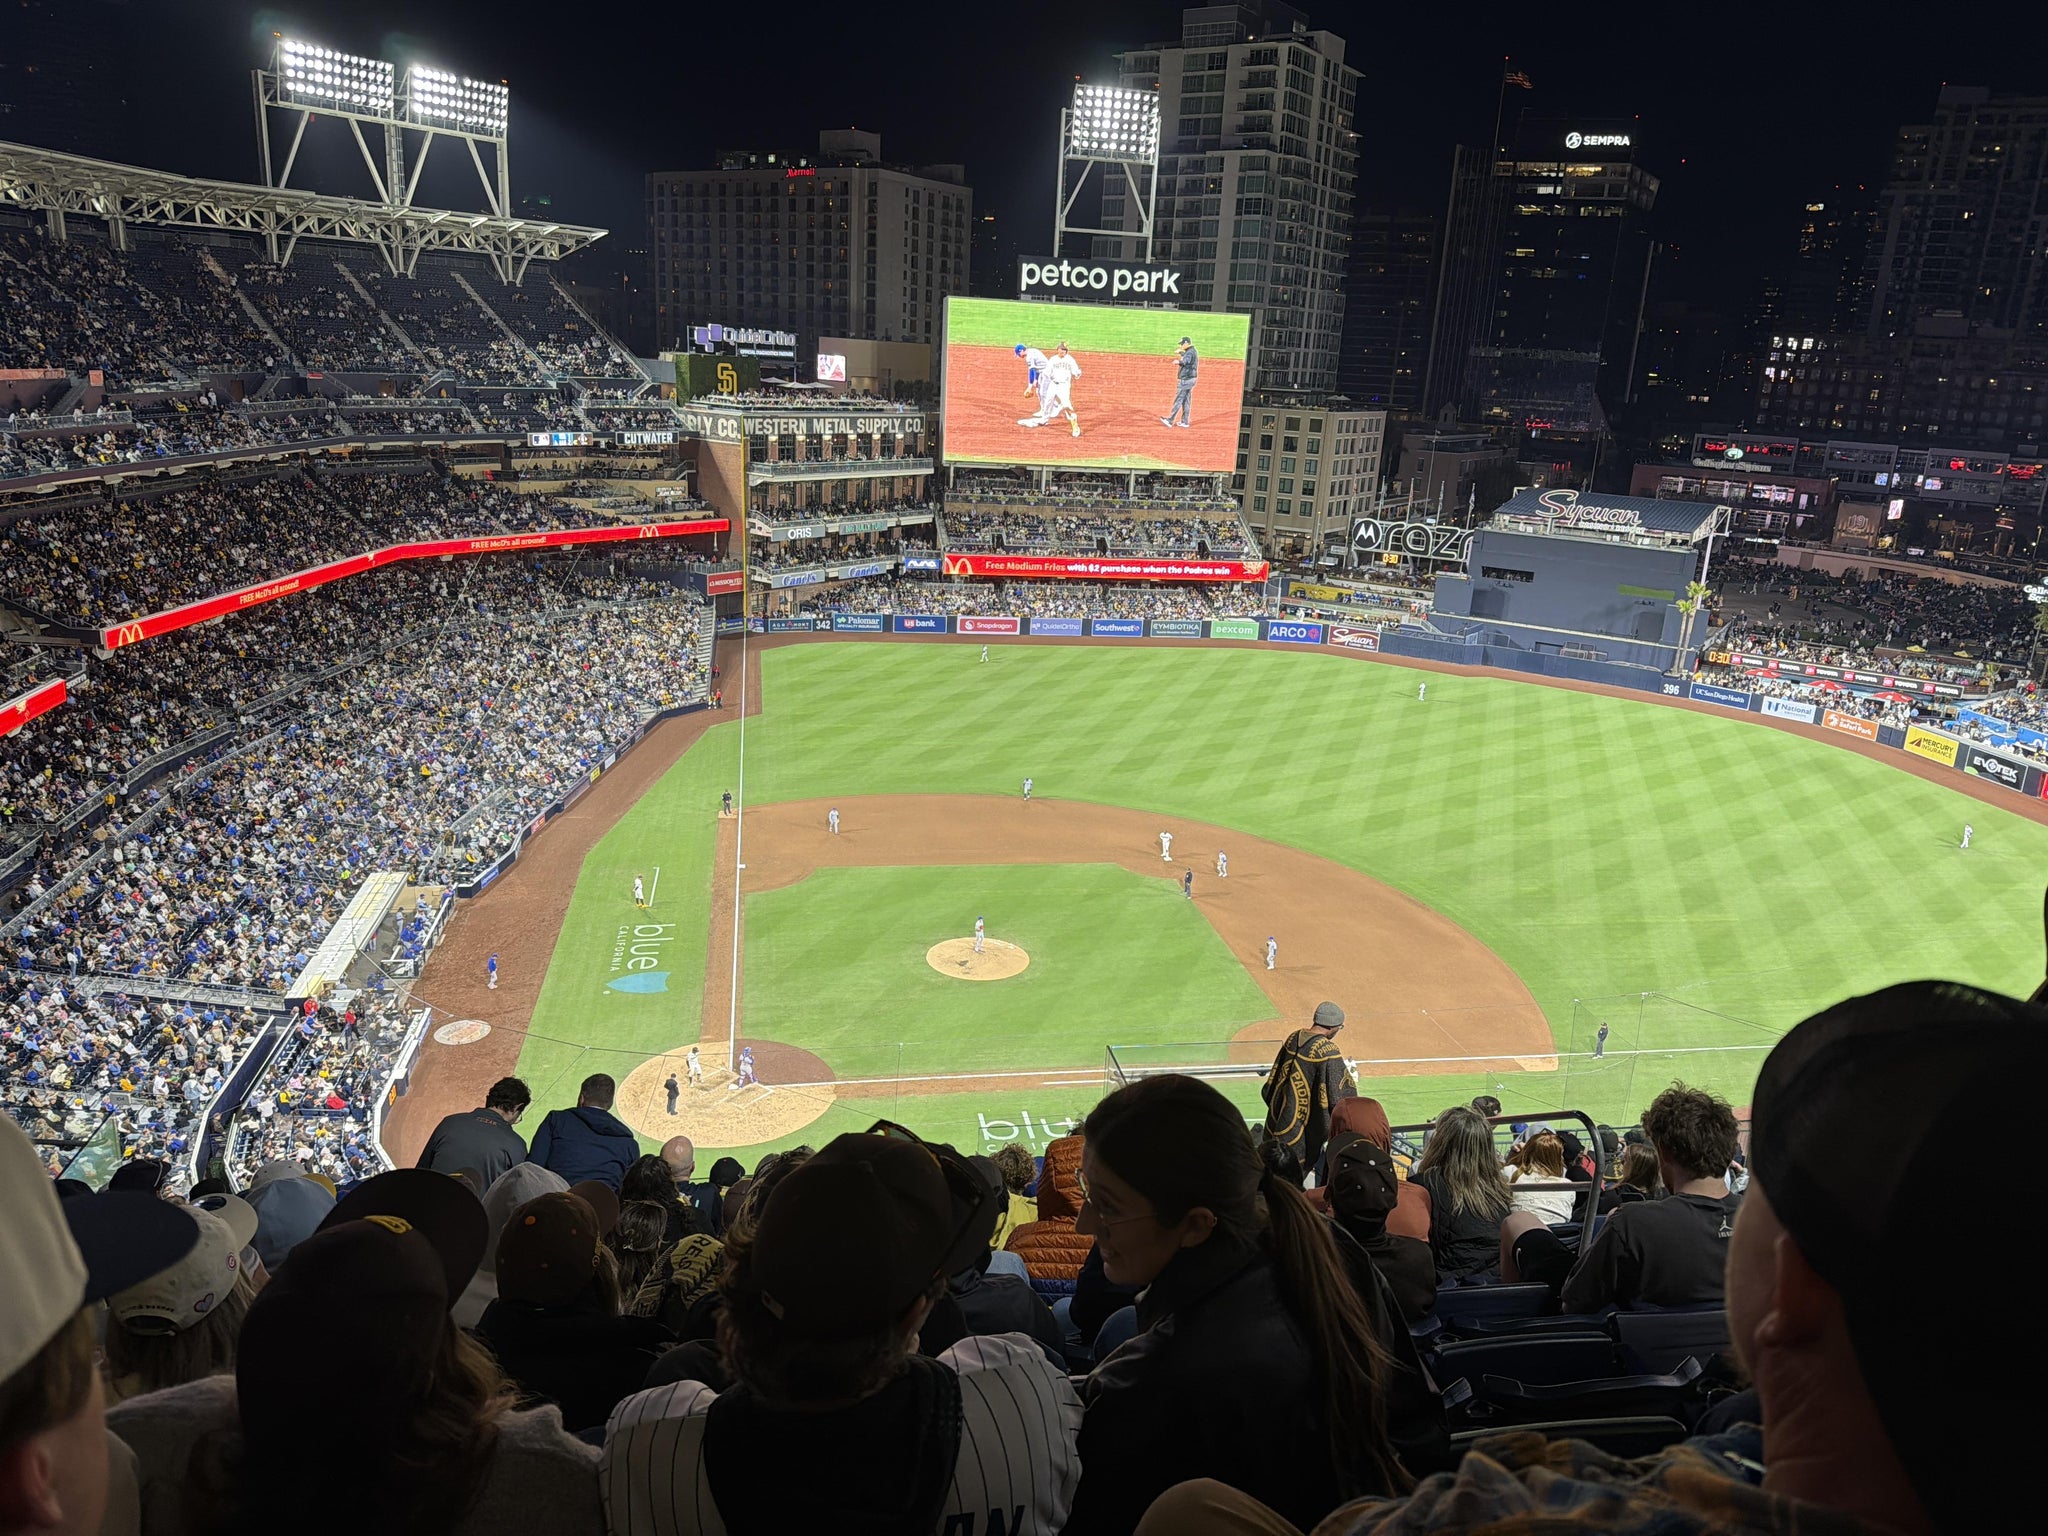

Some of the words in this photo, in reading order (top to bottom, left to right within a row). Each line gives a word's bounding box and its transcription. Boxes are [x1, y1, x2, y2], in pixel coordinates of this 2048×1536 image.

[1583, 136, 1630, 146] SEMPRA
[1021, 259, 1108, 291] petco
[1112, 269, 1181, 297] park
[723, 326, 796, 347] QuidelOrtho
[717, 418, 741, 439] CO.
[744, 417, 807, 434] WESTERN
[813, 417, 851, 433] METAL
[856, 417, 901, 433] SUPPLY
[905, 417, 923, 433] CO.
[623, 432, 673, 444] CUTWATER
[1536, 489, 1642, 527] Sycuan
[788, 528, 812, 539] ORIS
[471, 541, 489, 549] FREE
[1384, 521, 1475, 561] razr
[985, 561, 1004, 570] Free
[1006, 561, 1043, 571] Medium
[1044, 563, 1066, 571] Fries
[1067, 563, 1087, 572] with
[1100, 565, 1142, 574] purchase
[1143, 565, 1167, 573] when
[1167, 566, 1183, 574] the
[1184, 566, 1213, 574] Padres
[1214, 566, 1230, 575] win
[240, 592, 255, 605] FREE
[815, 620, 831, 630] 342
[848, 616, 880, 625] Palomar
[915, 619, 935, 628] bank
[976, 621, 1012, 630] Snapdragon
[1042, 622, 1080, 631] QuidelOrtho
[1095, 623, 1135, 632] Southwest
[1270, 626, 1307, 639] ARCO
[1331, 629, 1374, 646] Sycuan
[1709, 651, 1731, 665] 0:30
[1742, 658, 1763, 666] TOYOTA
[1779, 663, 1801, 672] TOYOTA
[1817, 669, 1839, 677] TOYOTA
[1855, 674, 1878, 683] TOYOTA
[1895, 680, 1918, 689] TOYOTA
[1663, 683, 1681, 696] 396
[1695, 688, 1705, 696] UC
[1704, 690, 1714, 698] San
[1713, 692, 1728, 701] Diego
[1728, 695, 1745, 704] Health
[1935, 686, 1959, 695] TOYOTA
[1781, 703, 1812, 715] National
[1839, 721, 1858, 732] Safari
[1857, 726, 1873, 736] Park
[1921, 744, 1953, 759] INSURANCE
[1922, 737, 1954, 753] MERCURY
[1973, 756, 2020, 778] EVOTEK
[608, 925, 629, 972] CALIFORNIA
[627, 923, 676, 970] blue
[1290, 1071, 1308, 1121] PADRES
[977, 1111, 1073, 1140] blu
